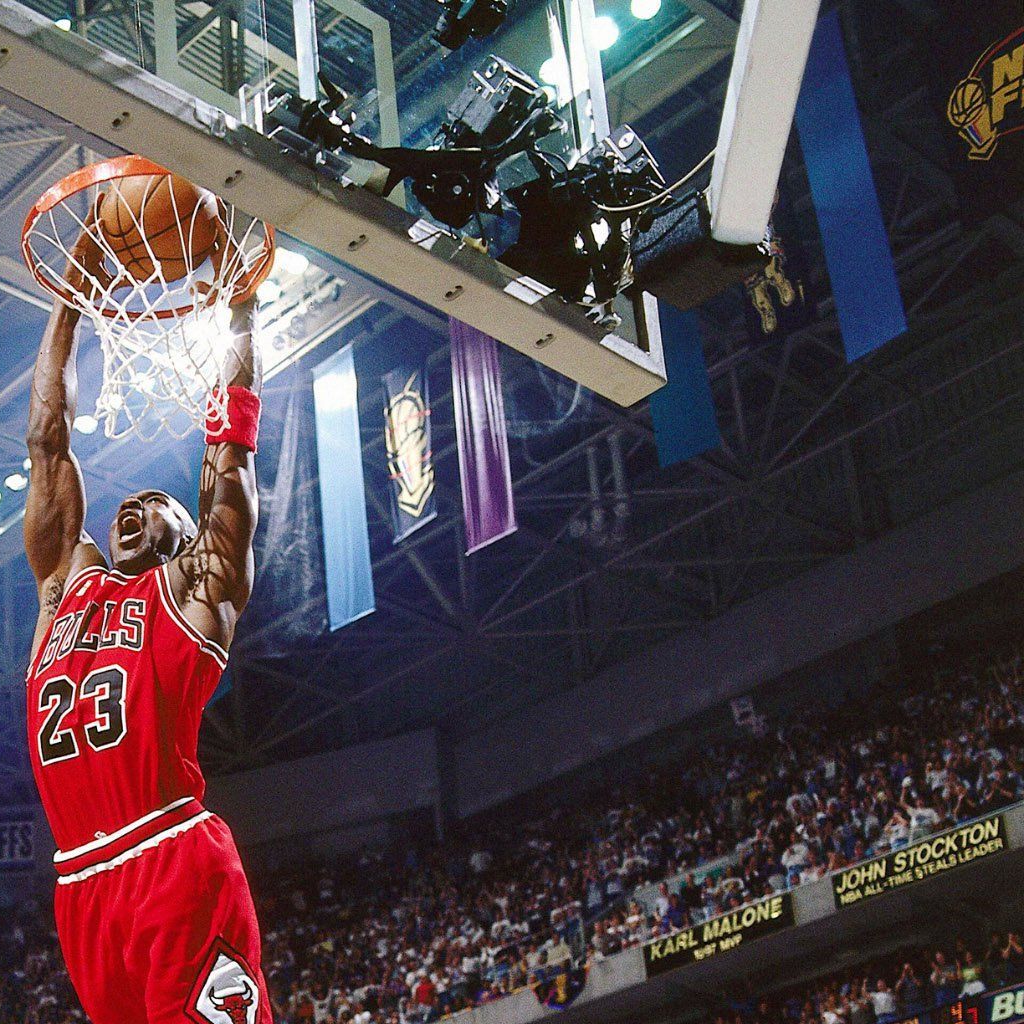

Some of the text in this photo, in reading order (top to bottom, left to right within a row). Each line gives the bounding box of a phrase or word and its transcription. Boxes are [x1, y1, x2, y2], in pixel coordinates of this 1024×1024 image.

[35, 598, 146, 680] BULLS
[38, 664, 128, 766] 23
[836, 817, 1000, 894] JOHN STOCKTON
[839, 837, 1004, 905] NBA ALL-TIME STEALS LEADER
[649, 896, 784, 962] KARL MALONE
